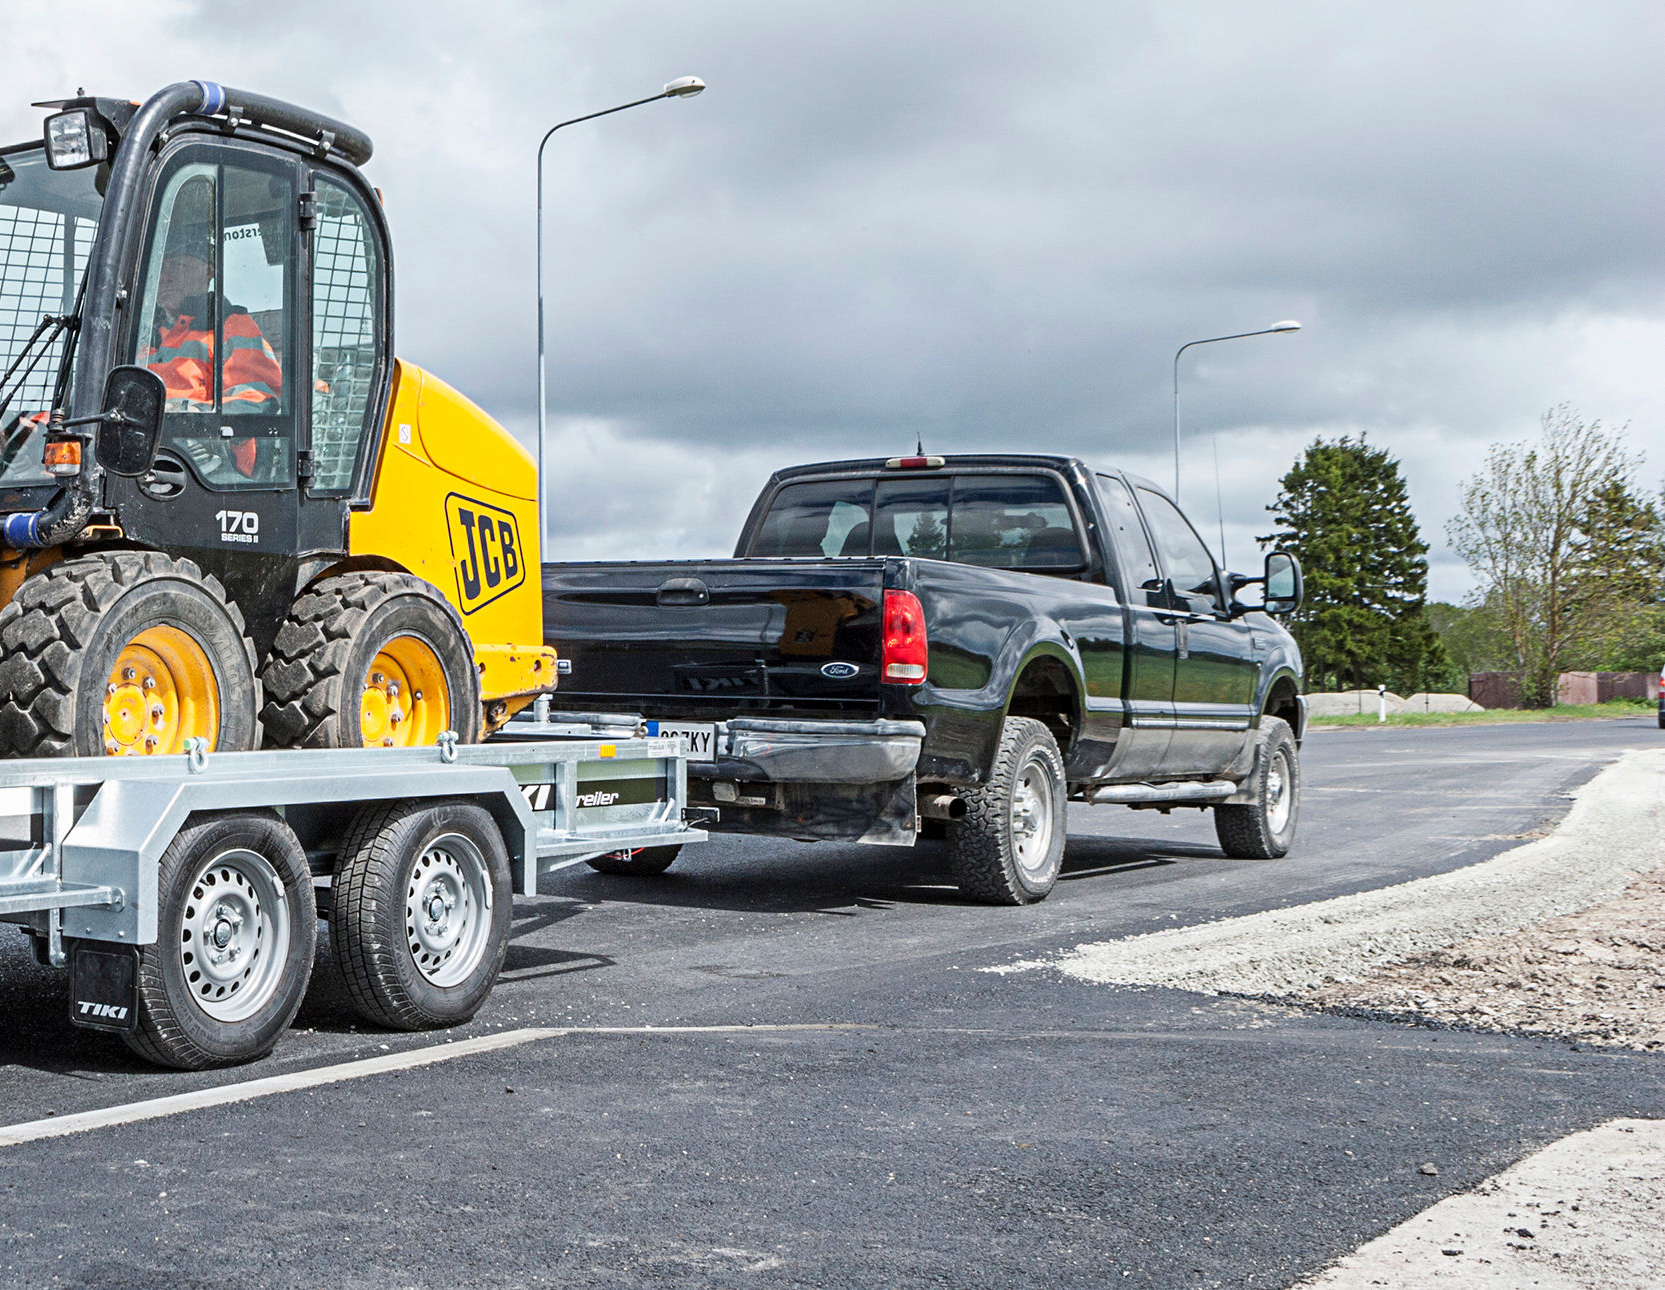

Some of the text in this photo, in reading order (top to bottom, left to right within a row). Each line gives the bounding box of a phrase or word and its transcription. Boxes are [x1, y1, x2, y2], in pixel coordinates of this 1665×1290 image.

[215, 510, 259, 534] 170
[221, 533, 252, 543] SERIES
[458, 507, 518, 600] JCB
[519, 784, 619, 810] KI reiler
[77, 1001, 128, 1019] TIKI
